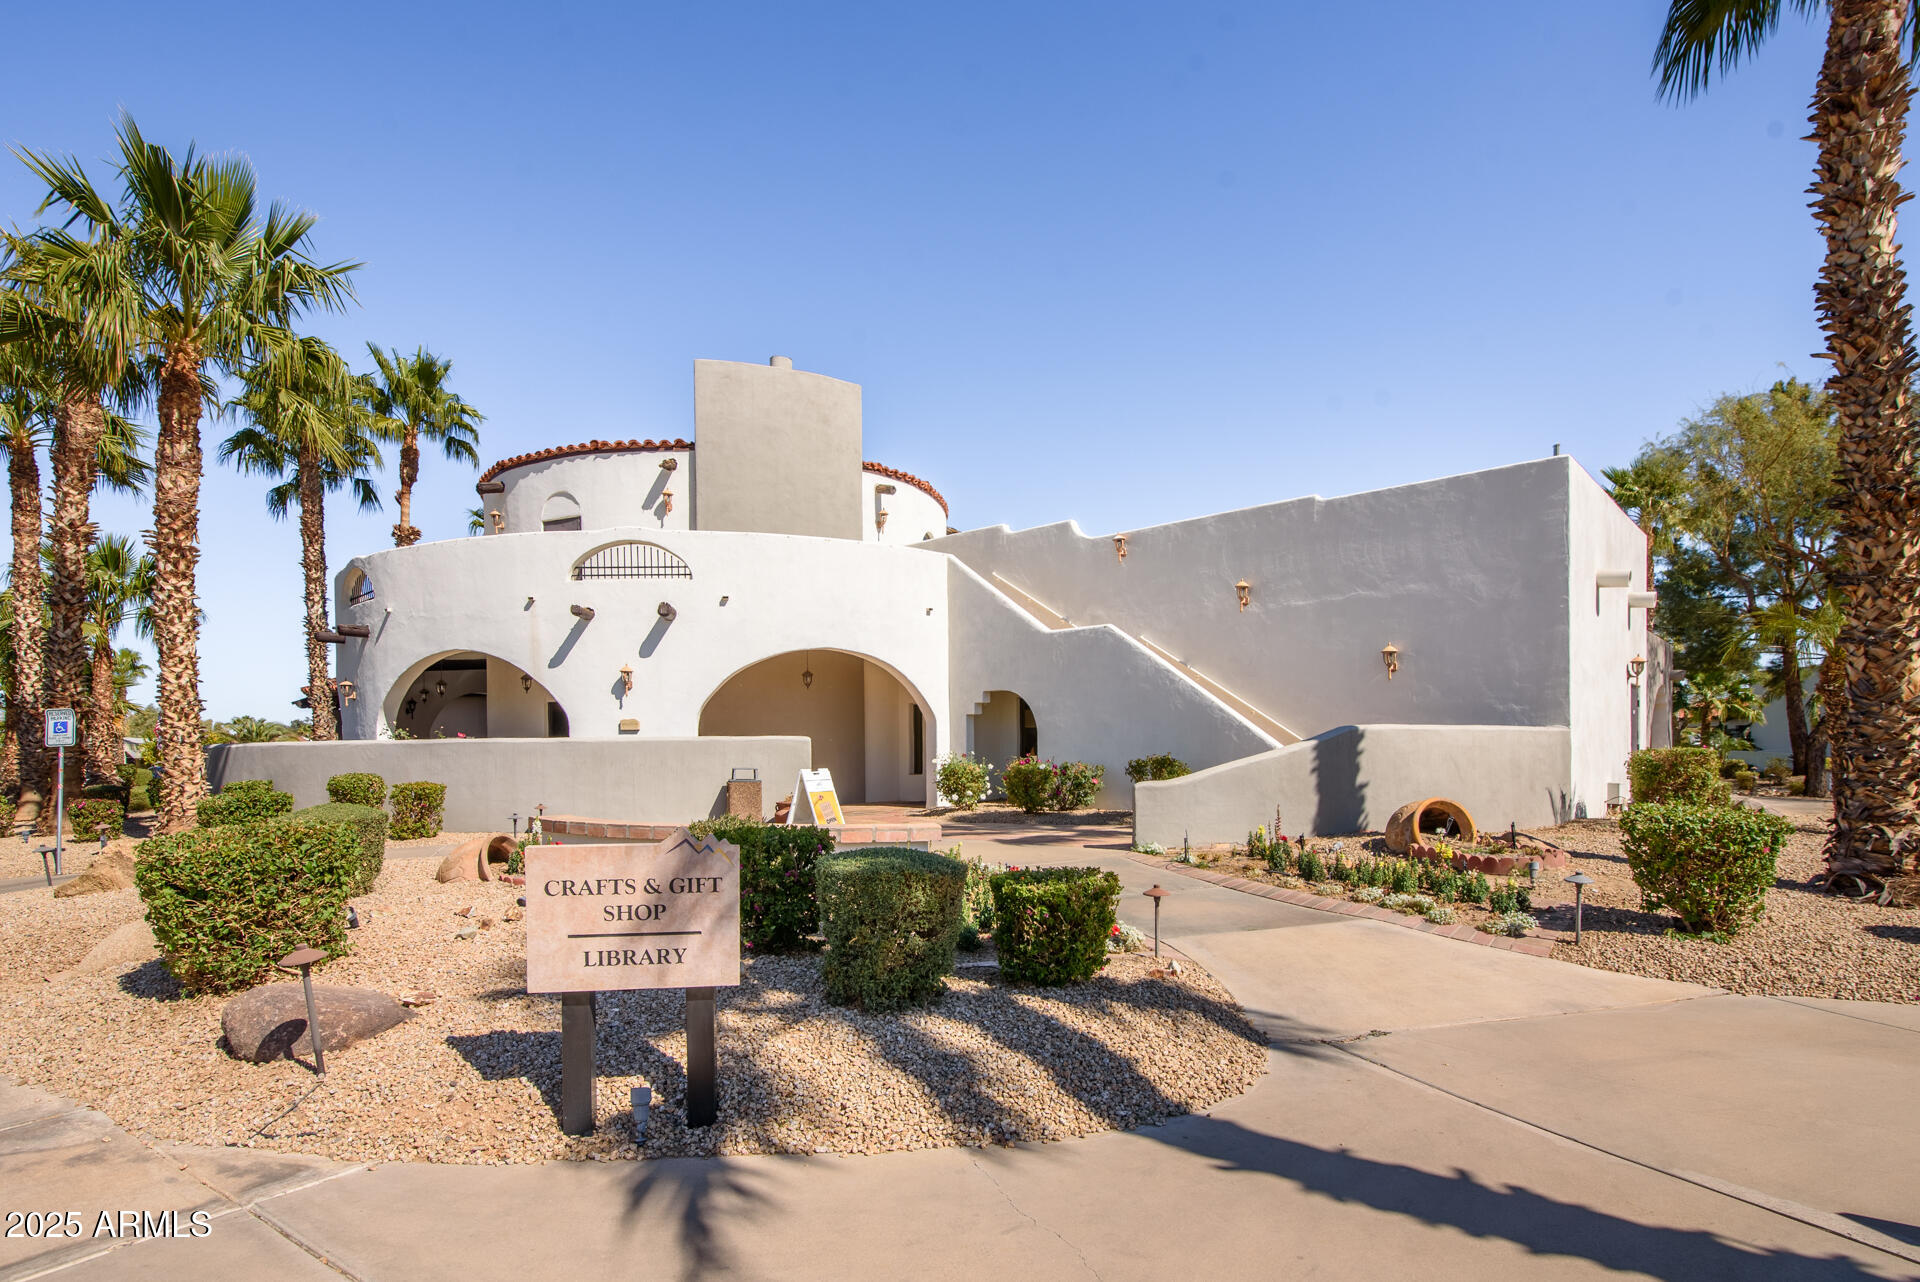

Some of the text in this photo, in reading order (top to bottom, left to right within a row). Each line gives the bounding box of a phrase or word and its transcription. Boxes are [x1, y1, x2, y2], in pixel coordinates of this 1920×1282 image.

[544, 876, 723, 896] CRAFTS & GIFT
[603, 904, 667, 921] SHOP
[583, 948, 688, 967] LIBRARY
